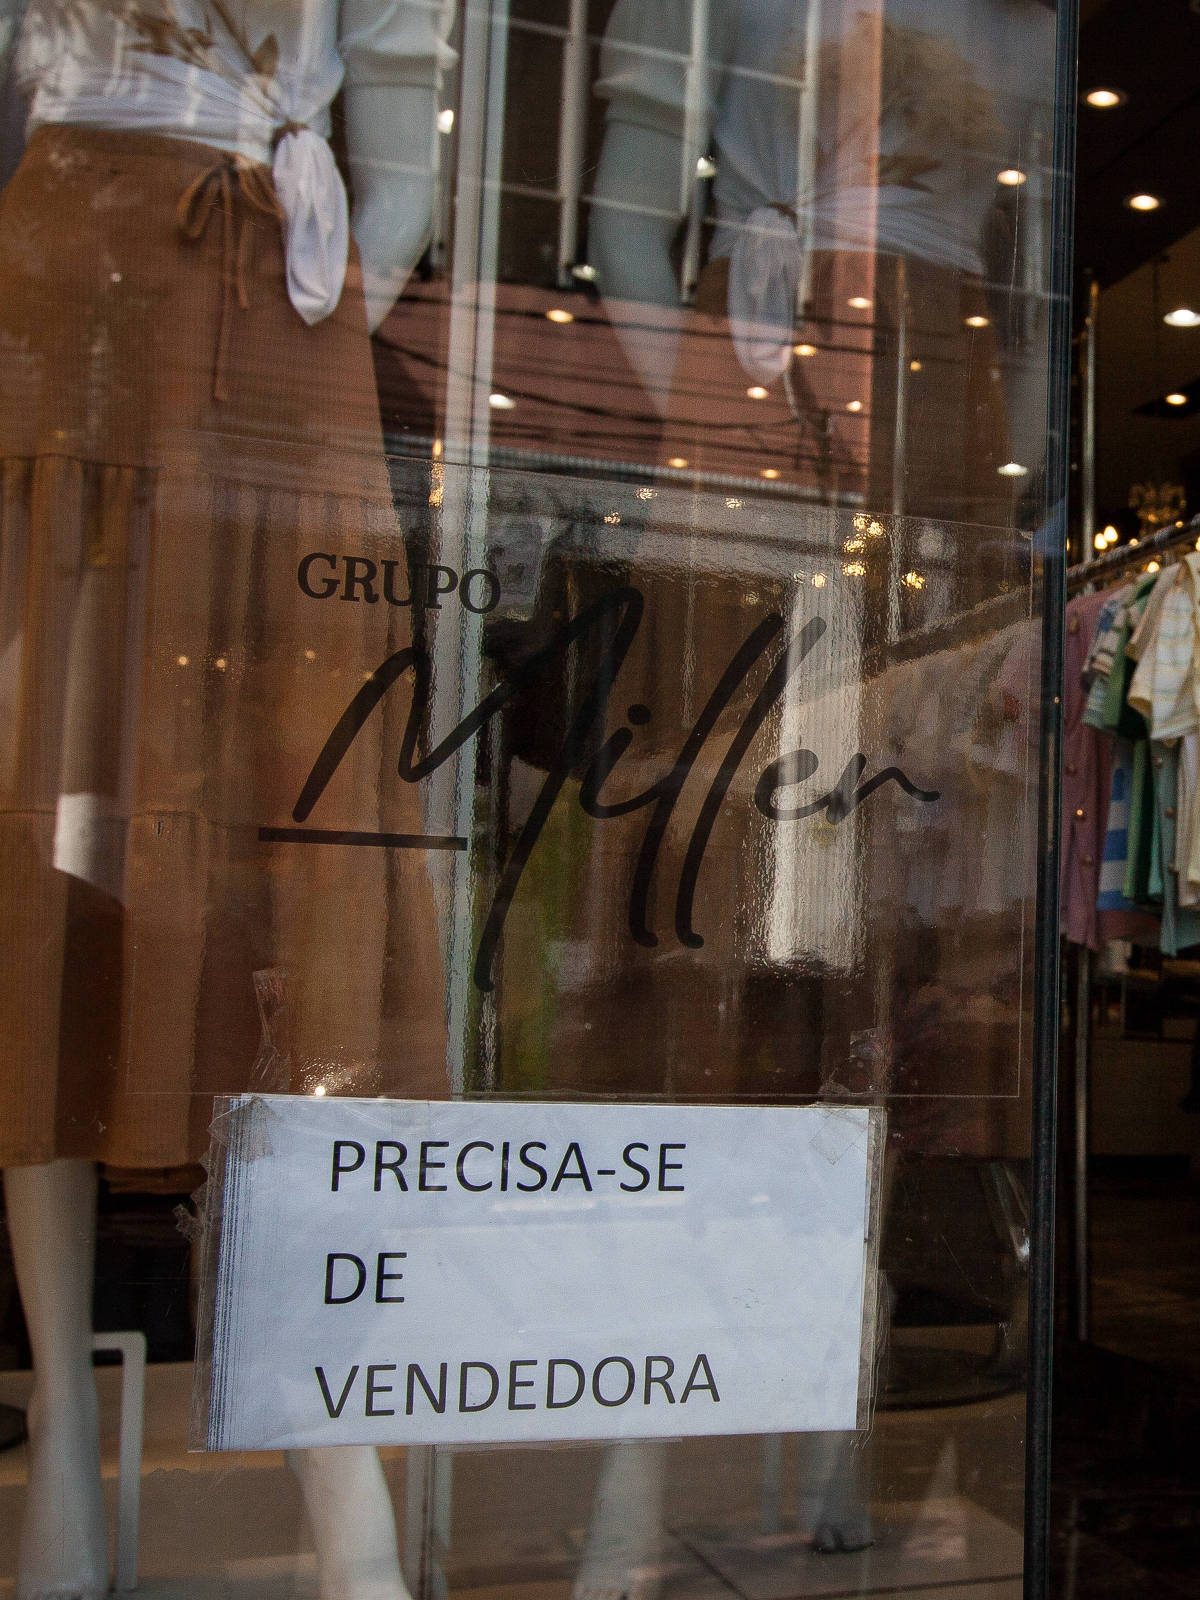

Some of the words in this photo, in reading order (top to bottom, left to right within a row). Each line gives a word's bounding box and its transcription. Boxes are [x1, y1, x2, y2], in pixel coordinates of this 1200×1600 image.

[297, 551, 501, 615] GRUPO
[329, 1139, 687, 1193] PRECISA-SE
[323, 1251, 408, 1305] DE
[314, 1353, 721, 1419] VENDEDORA
